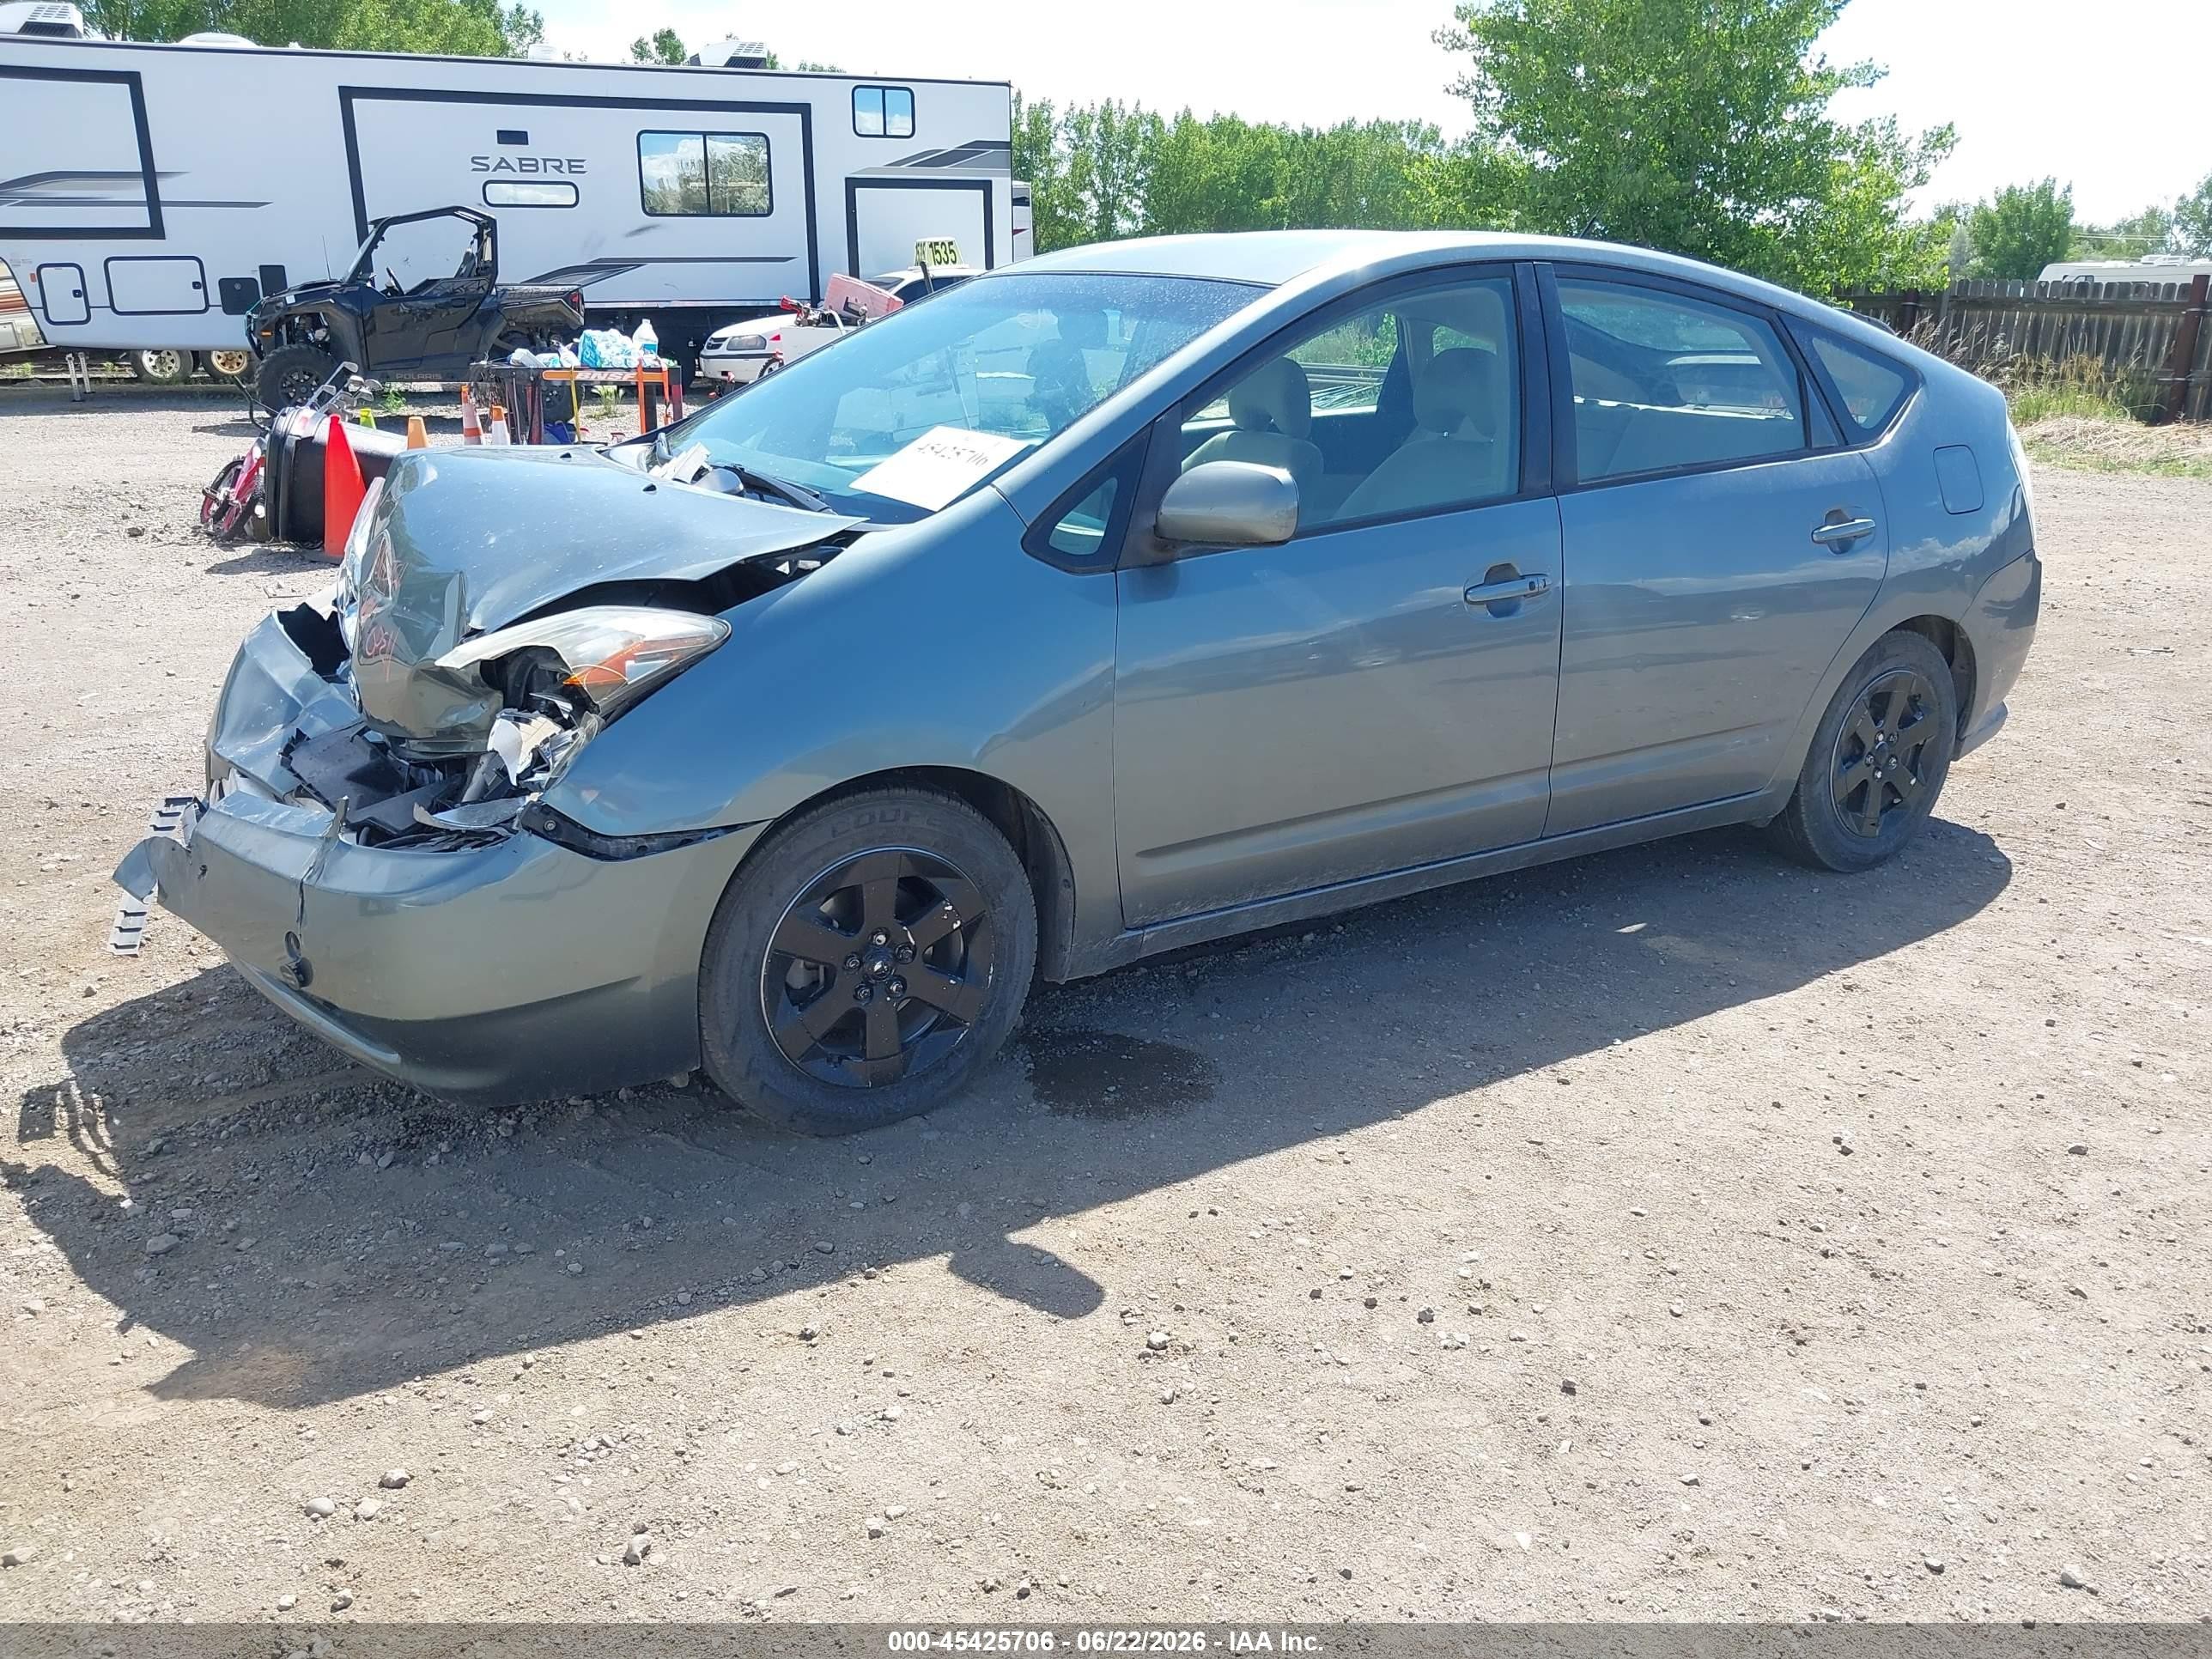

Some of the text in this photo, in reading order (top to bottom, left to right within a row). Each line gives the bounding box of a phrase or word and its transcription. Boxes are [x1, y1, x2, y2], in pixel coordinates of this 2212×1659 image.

[471, 155, 588, 174] SABRE
[928, 240, 957, 265] 1535
[575, 371, 638, 381] BNSF
